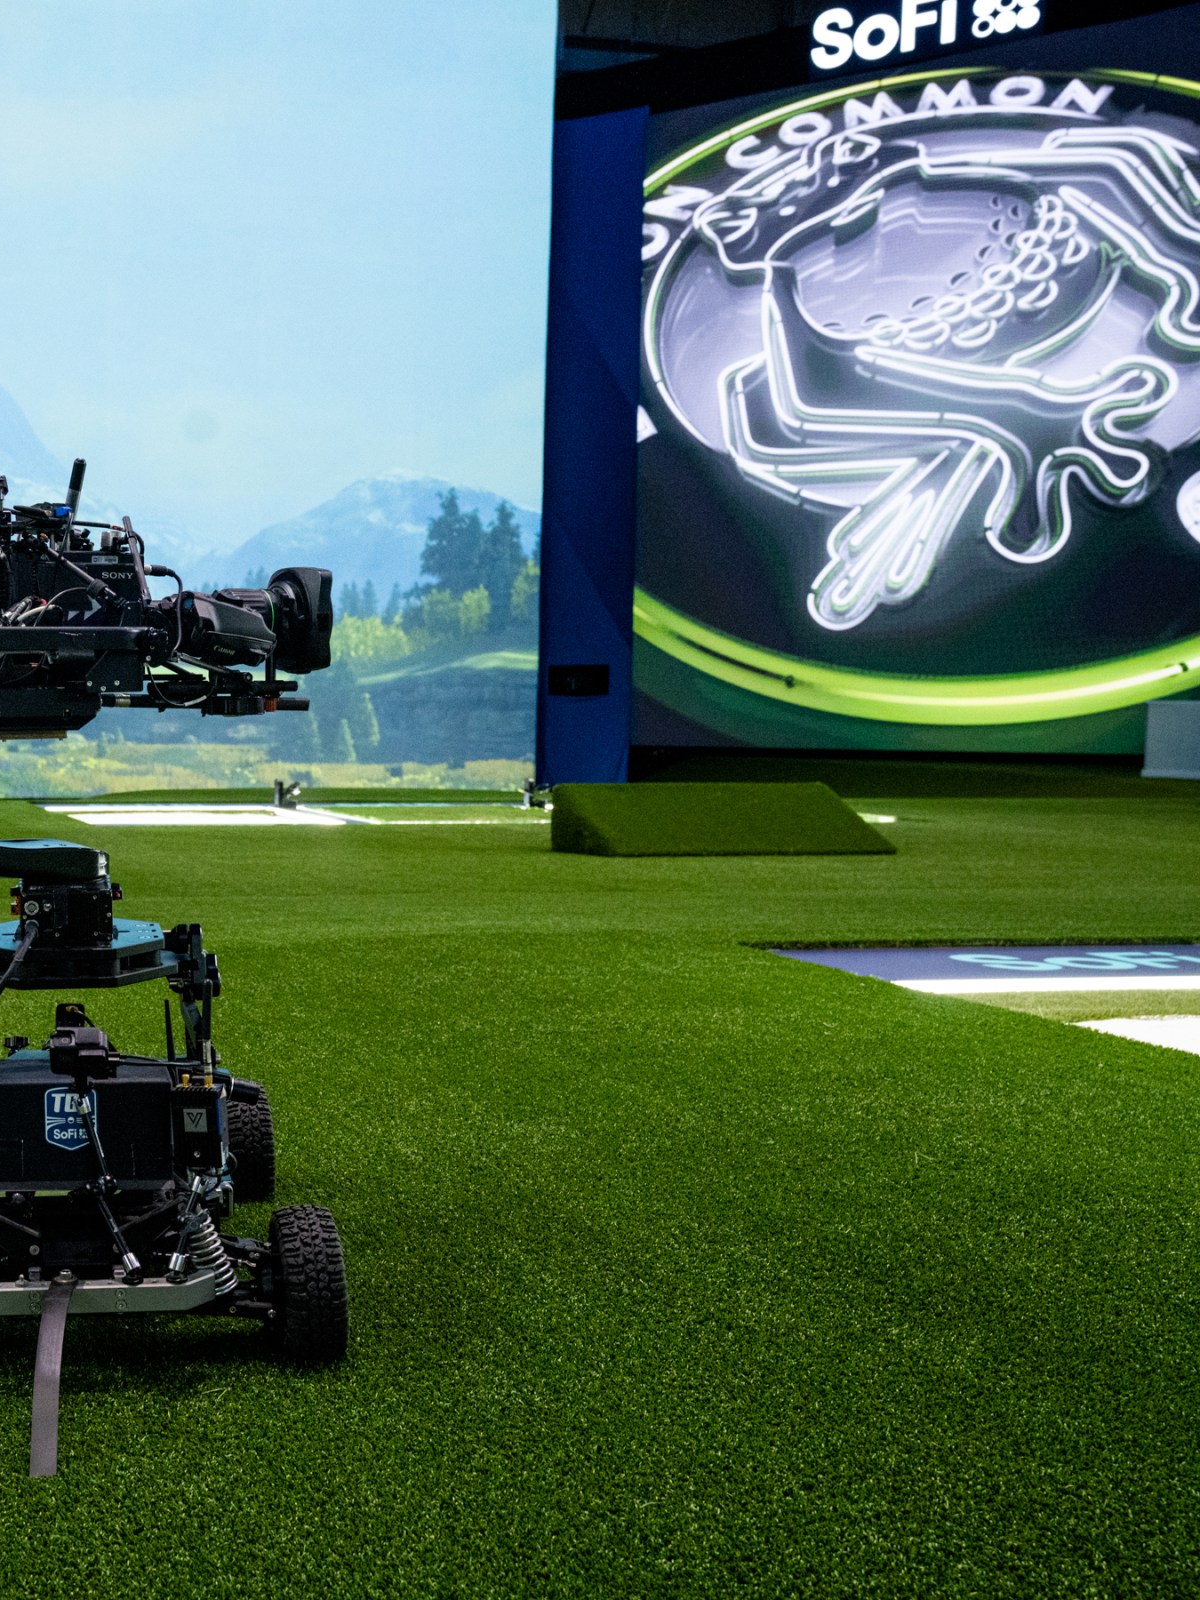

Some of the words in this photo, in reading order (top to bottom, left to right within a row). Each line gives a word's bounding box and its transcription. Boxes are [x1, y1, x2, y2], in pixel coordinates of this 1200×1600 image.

[725, 75, 1116, 169] COMMON
[101, 571, 134, 580] SONY
[51, 1093, 91, 1113] TG
[53, 1128, 78, 1140] SoFi
